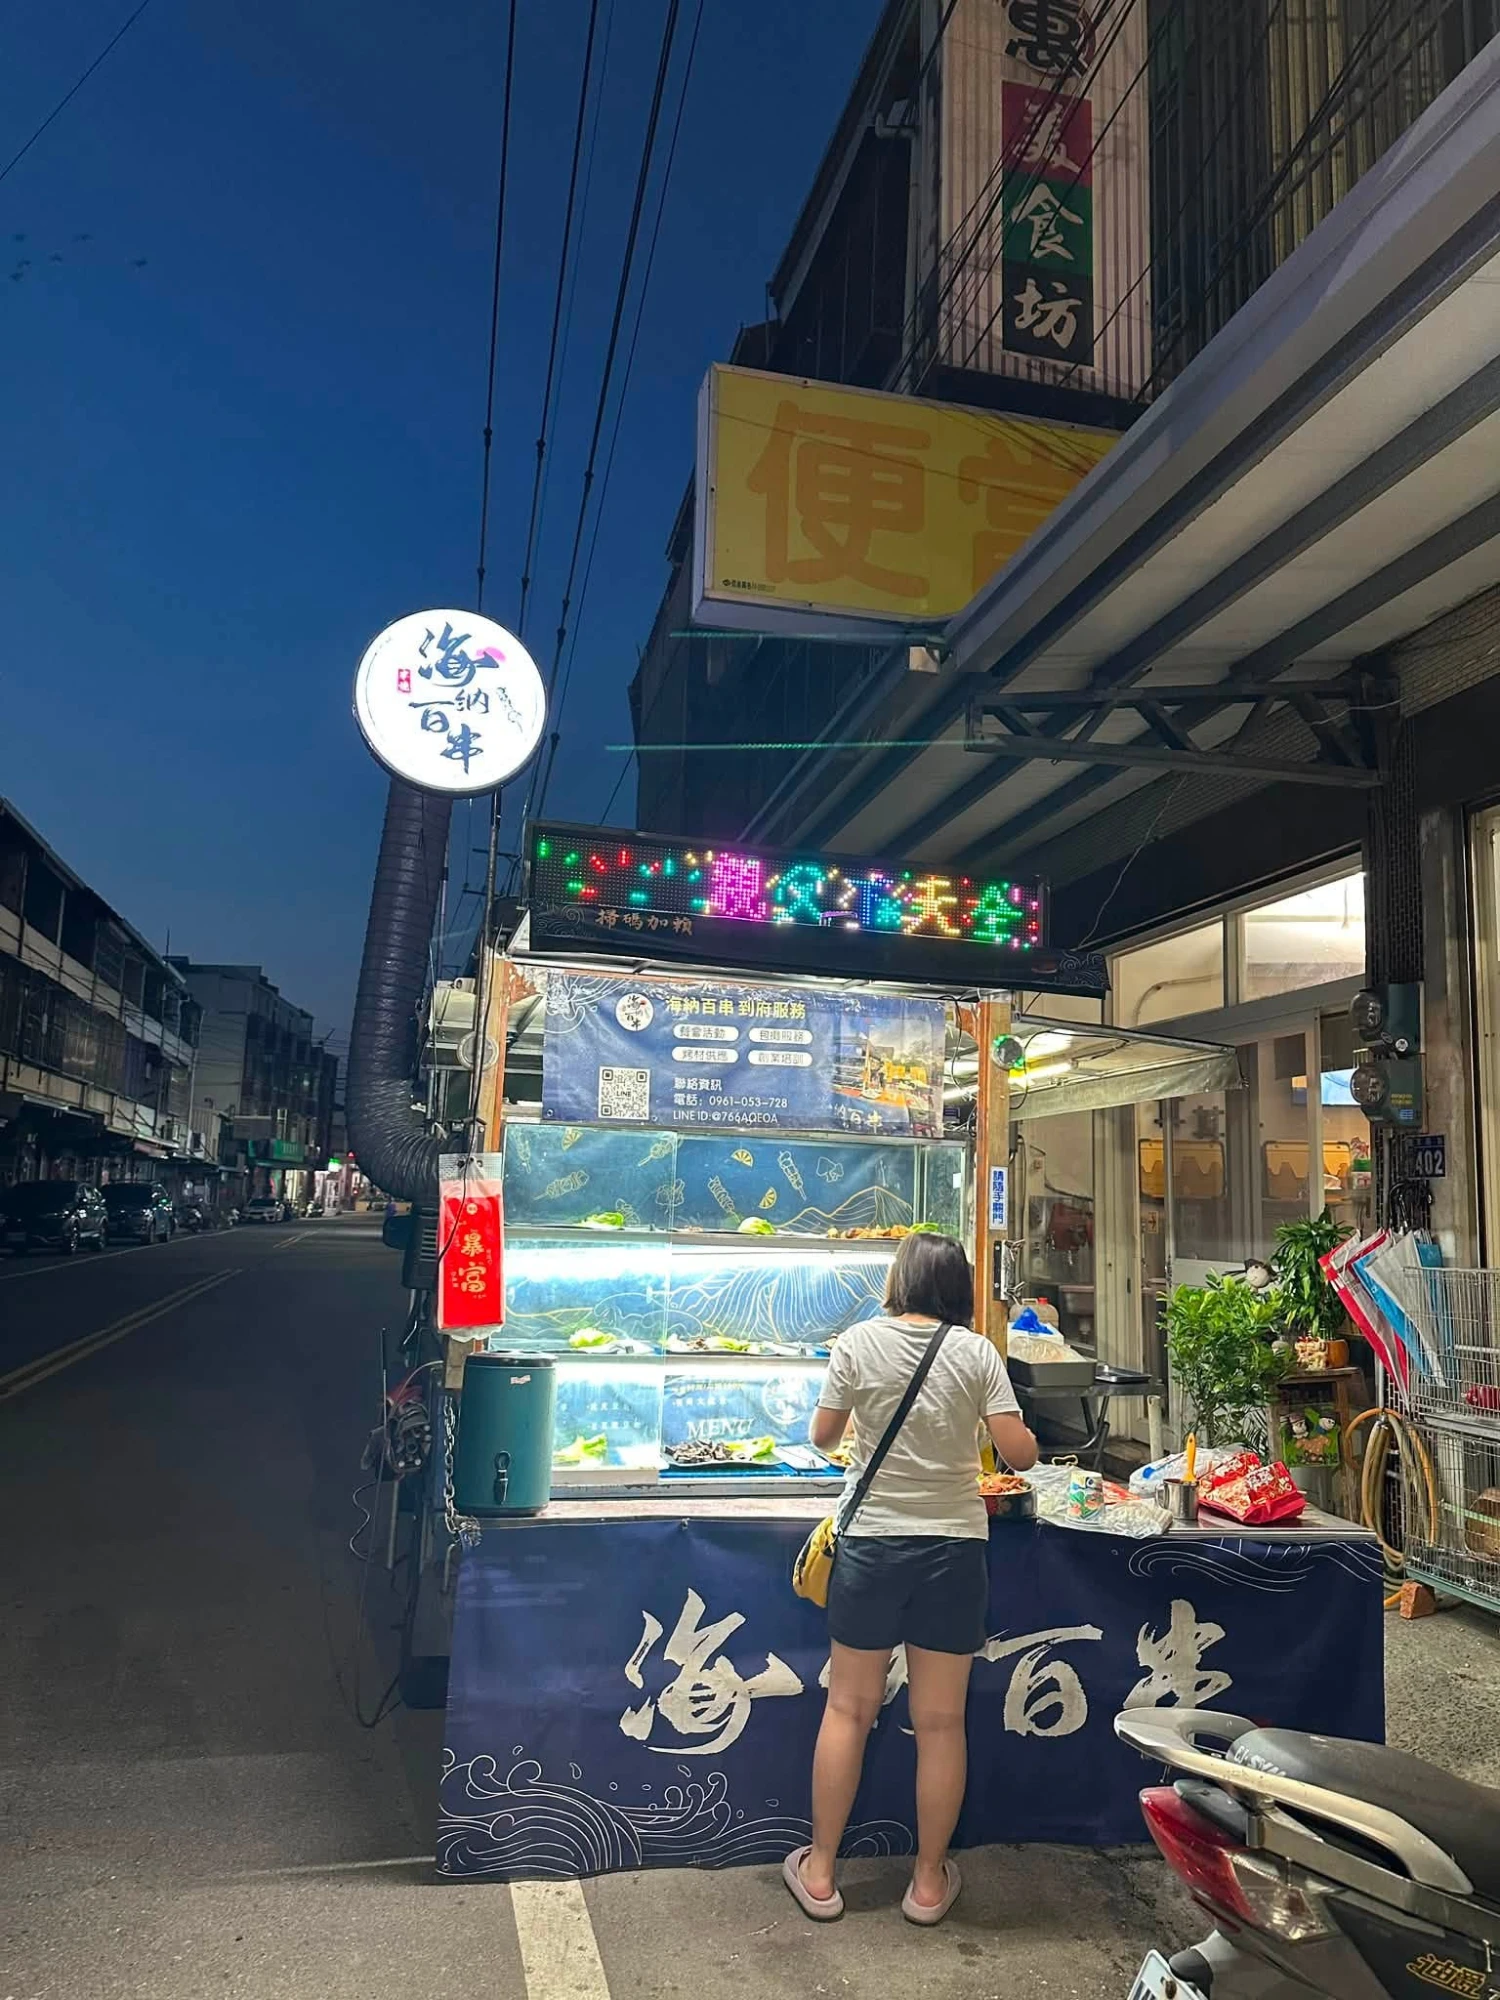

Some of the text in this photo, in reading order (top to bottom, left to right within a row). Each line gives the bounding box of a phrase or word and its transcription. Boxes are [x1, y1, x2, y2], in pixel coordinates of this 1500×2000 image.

[1009, 97, 1085, 350] 美食坊
[666, 996, 806, 1020] 海納百串 到府服務
[673, 1077, 722, 1092] 聯絡資訊
[673, 1111, 695, 1121] LINE
[1415, 1149, 1444, 1175] 402
[992, 1170, 1004, 1224] 請隨手關門
[687, 1417, 754, 1438] MENU
